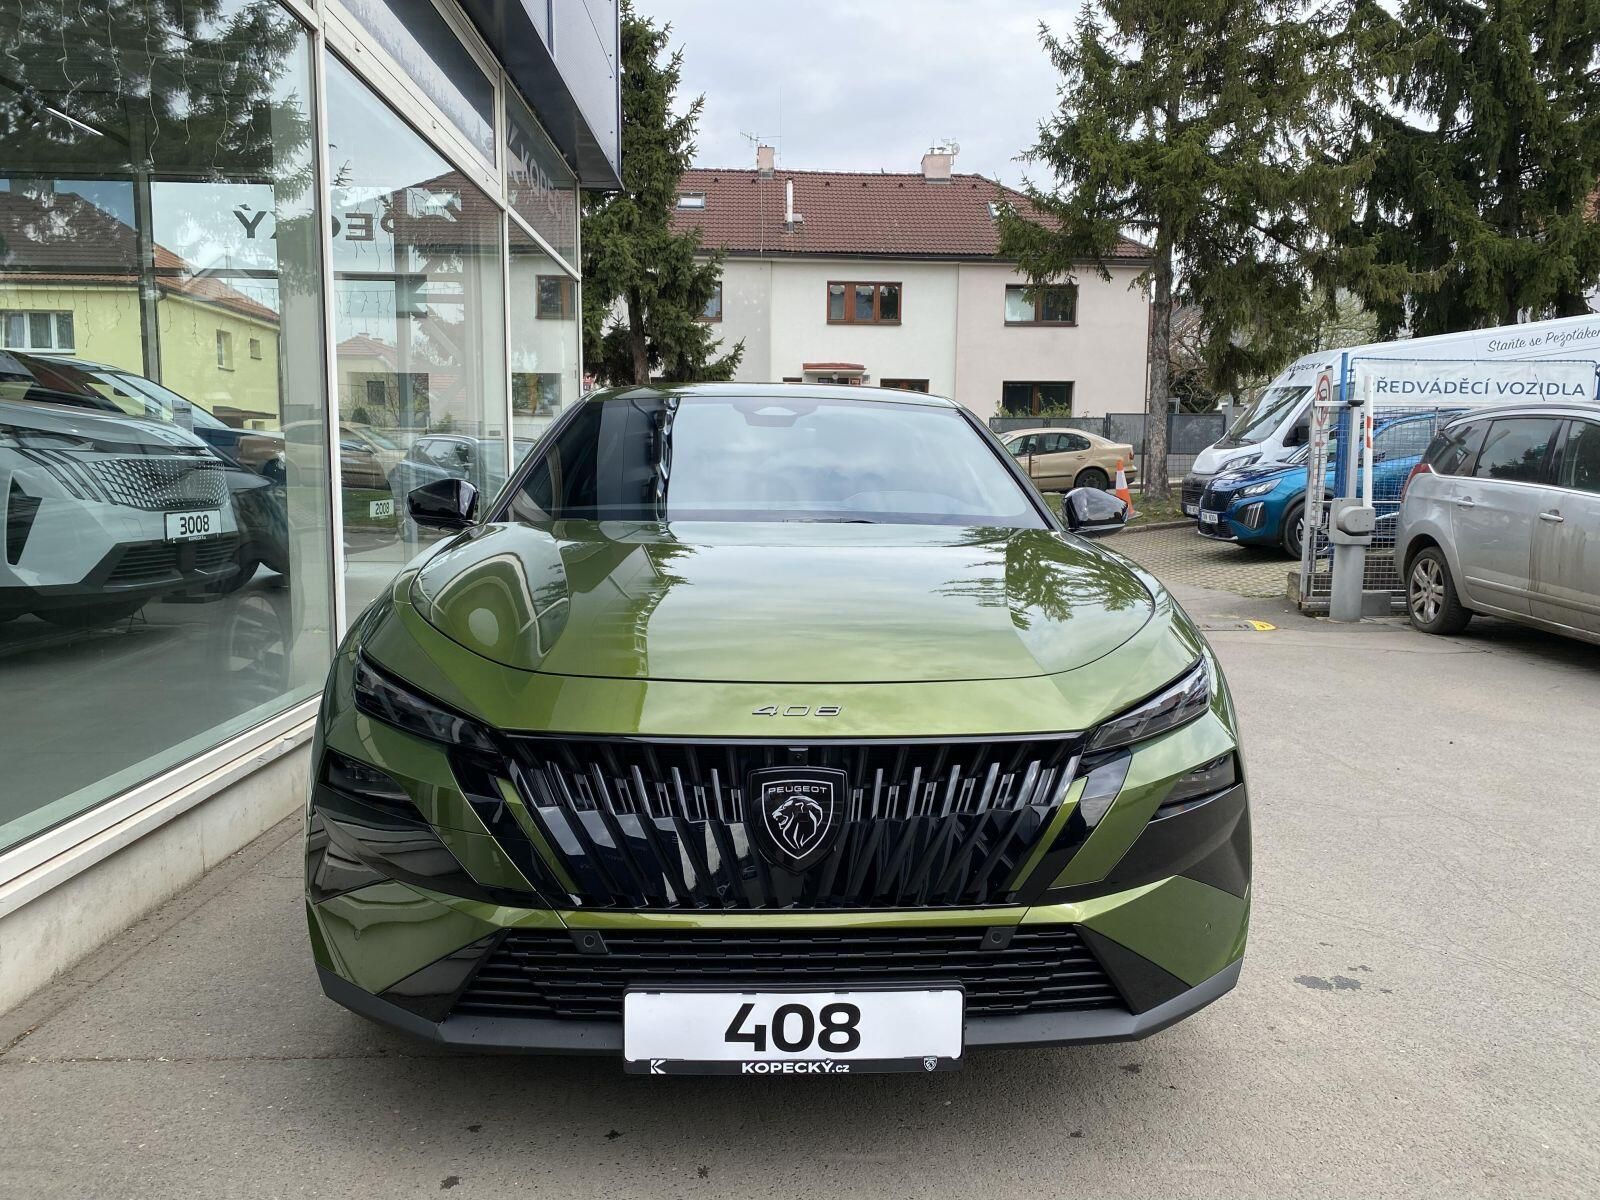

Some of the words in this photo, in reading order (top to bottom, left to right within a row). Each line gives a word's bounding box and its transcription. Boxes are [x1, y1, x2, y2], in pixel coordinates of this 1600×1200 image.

[1487, 338, 1526, 353] Staňte
[1529, 336, 1543, 347] se
[1364, 377, 1490, 395] ŘEDVÁDĚCÍ
[1496, 381, 1586, 397] VOZIDLA
[180, 514, 210, 535] 3008
[751, 704, 843, 717] 408
[768, 785, 828, 794] PEUGEOT
[724, 1002, 861, 1053] 408
[741, 1058, 850, 1074] KOPECKÝ.cz
